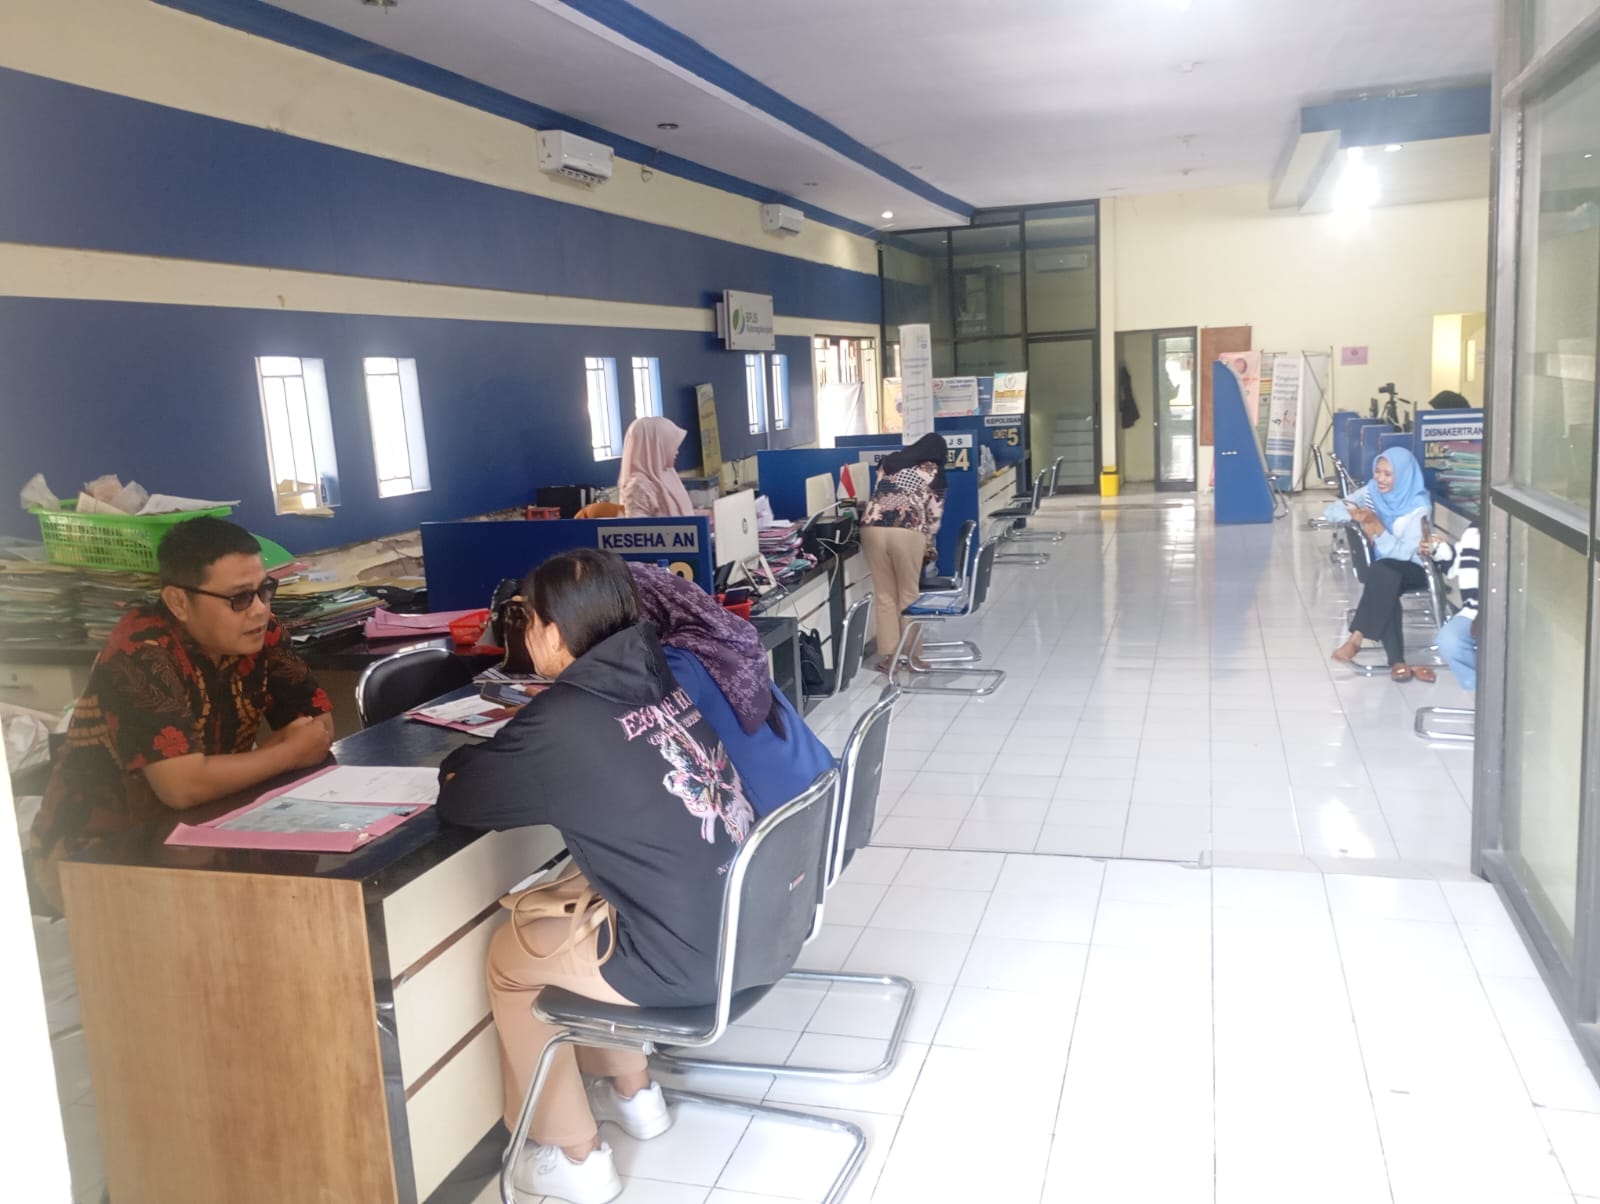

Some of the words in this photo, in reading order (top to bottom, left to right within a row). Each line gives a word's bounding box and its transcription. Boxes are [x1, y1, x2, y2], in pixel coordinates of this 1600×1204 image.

[1007, 427, 1019, 447] 5
[955, 448, 970, 471] 4
[602, 532, 695, 549] KESEHAAN
